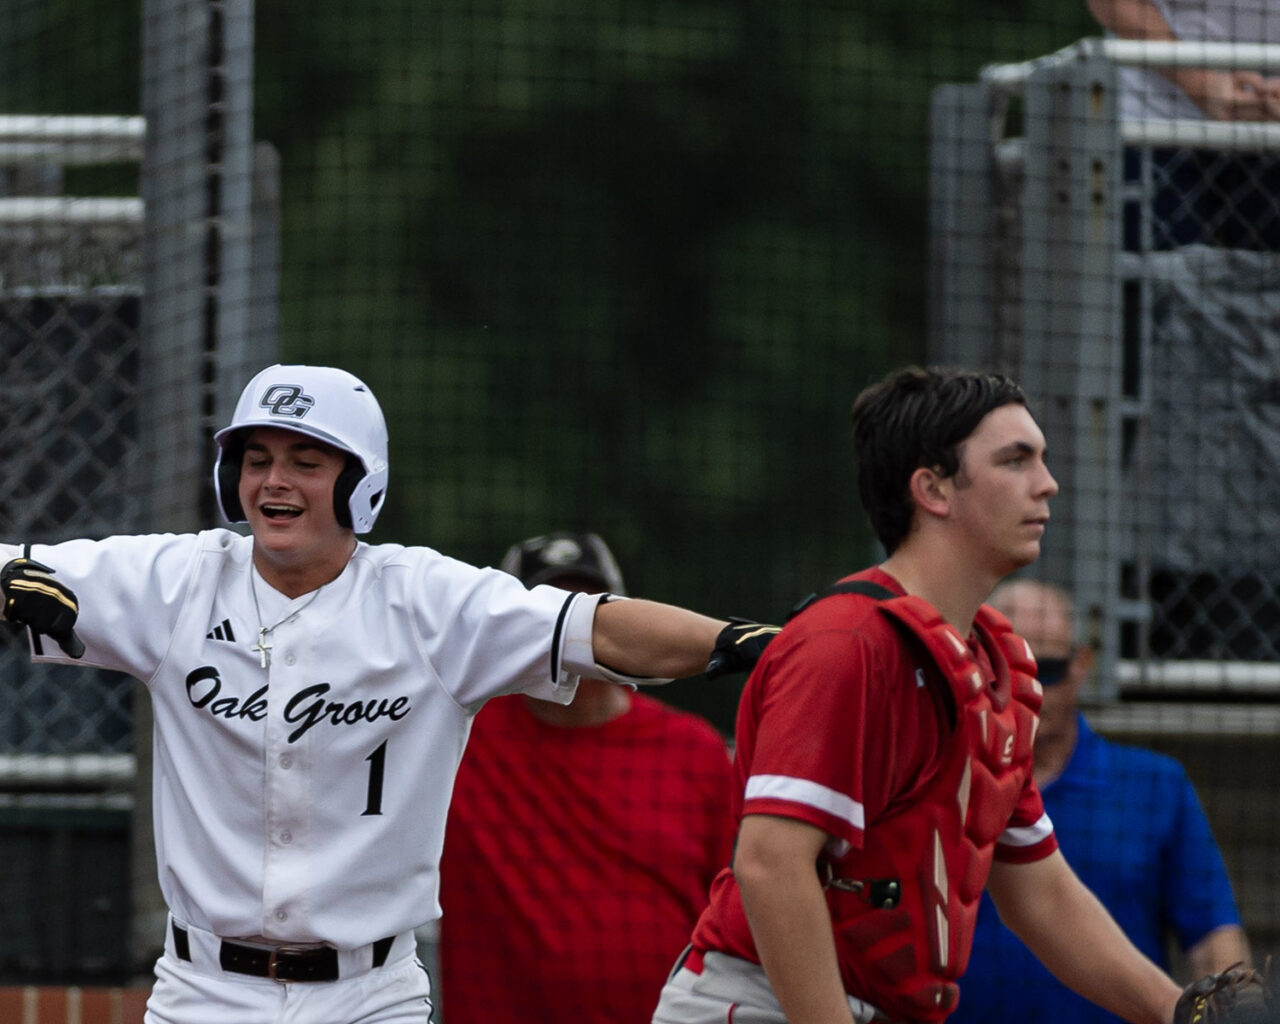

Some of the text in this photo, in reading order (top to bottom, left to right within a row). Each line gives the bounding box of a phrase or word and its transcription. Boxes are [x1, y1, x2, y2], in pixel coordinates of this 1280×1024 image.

[259, 384, 315, 419] OG
[185, 666, 411, 744] Oak Grove
[360, 739, 388, 817] 1
